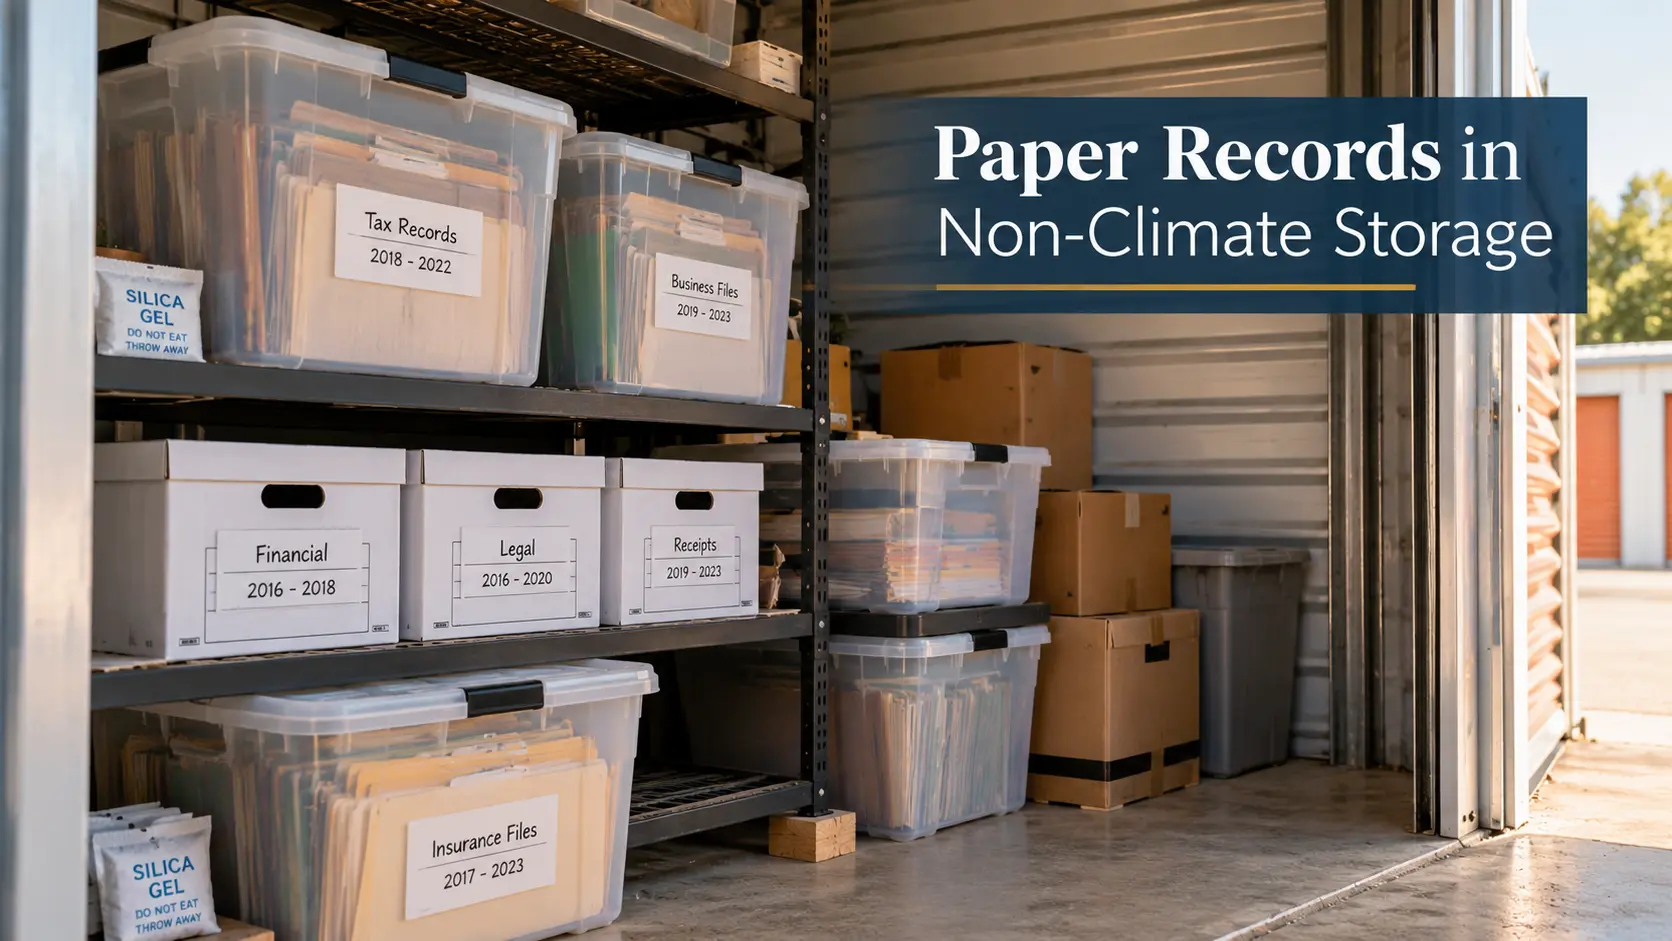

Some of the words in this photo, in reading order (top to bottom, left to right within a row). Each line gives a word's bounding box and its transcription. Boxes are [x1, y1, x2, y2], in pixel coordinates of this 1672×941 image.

[365, 212, 391, 232] Tax
[399, 218, 456, 243] Records
[371, 248, 402, 266] 2018
[419, 256, 451, 274] 2022
[672, 274, 714, 294] Business
[718, 282, 738, 298] Files
[126, 289, 185, 310] SILICA
[140, 309, 174, 326] GEL
[677, 304, 698, 317] 2019
[709, 309, 730, 322] 2023
[128, 328, 142, 337] DO
[146, 330, 165, 339] NOT
[169, 333, 187, 342] EAT
[126, 341, 160, 352] THROW
[163, 346, 188, 354] AWAY
[257, 543, 327, 563] Financial
[501, 539, 535, 561] Legal
[675, 537, 716, 558] Receipts
[482, 573, 509, 587] 2016
[524, 572, 552, 585] 2020
[667, 566, 688, 579] 2019
[699, 565, 721, 577] 2023
[248, 582, 283, 598] 2016
[302, 580, 335, 595] 2018
[433, 833, 501, 857] Insurance
[507, 822, 537, 842] Files
[133, 856, 194, 880] SILICA
[444, 868, 475, 889] 2017
[492, 858, 523, 878] 2023
[149, 879, 184, 898] GEL
[135, 908, 151, 919] DO
[155, 903, 177, 915] NOT
[180, 898, 198, 910] EAT
[135, 917, 173, 933] THROW
[176, 913, 201, 926] AWAY
